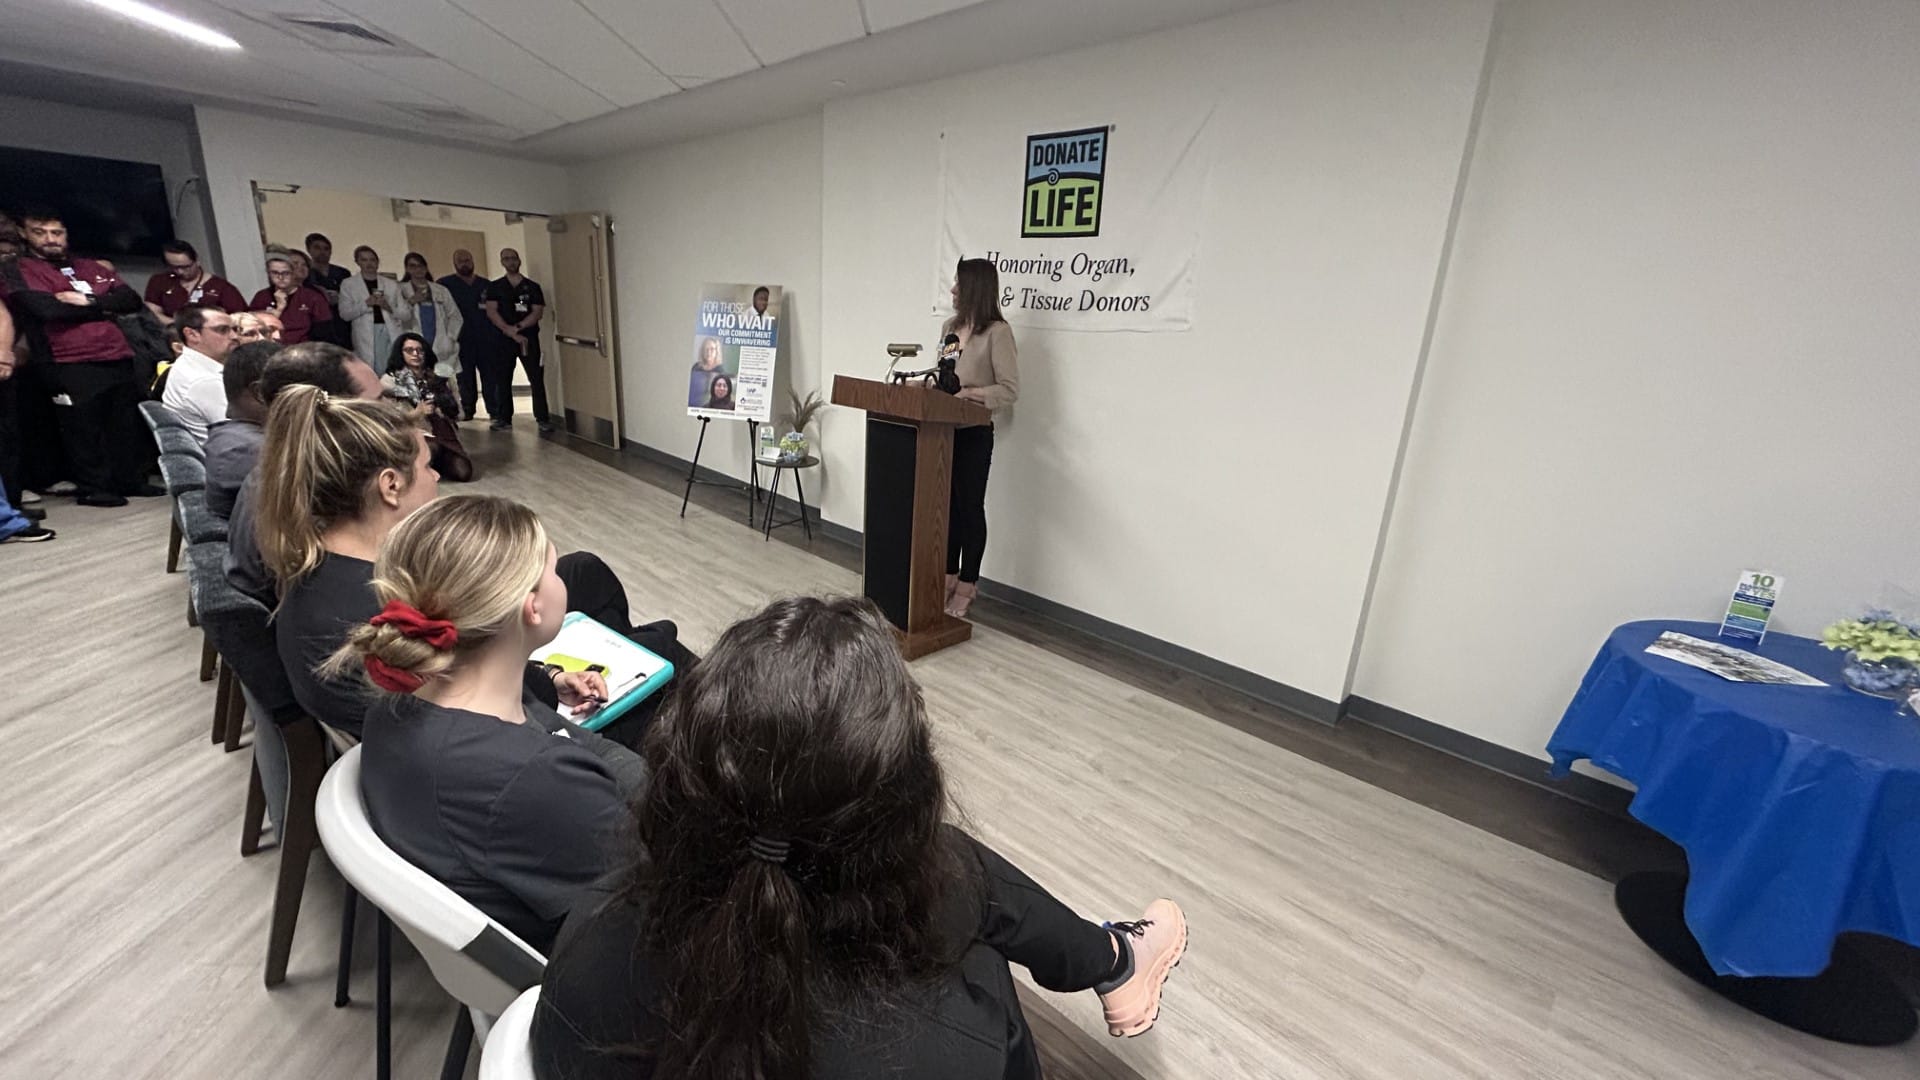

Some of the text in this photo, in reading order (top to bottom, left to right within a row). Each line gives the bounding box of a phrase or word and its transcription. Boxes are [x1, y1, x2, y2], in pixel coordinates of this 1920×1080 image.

[1033, 138, 1100, 167] DONATE
[1029, 186, 1094, 227] LIFE
[1070, 252, 1136, 282] Organ,
[703, 300, 746, 314] FOR THOSE
[1000, 286, 1150, 312] & Tissue Donors
[702, 313, 776, 331] WHO WAIT
[718, 328, 772, 339] OUR COMMITMENT
[732, 338, 771, 346] UNWAVERING
[1751, 574, 1775, 587] 10
